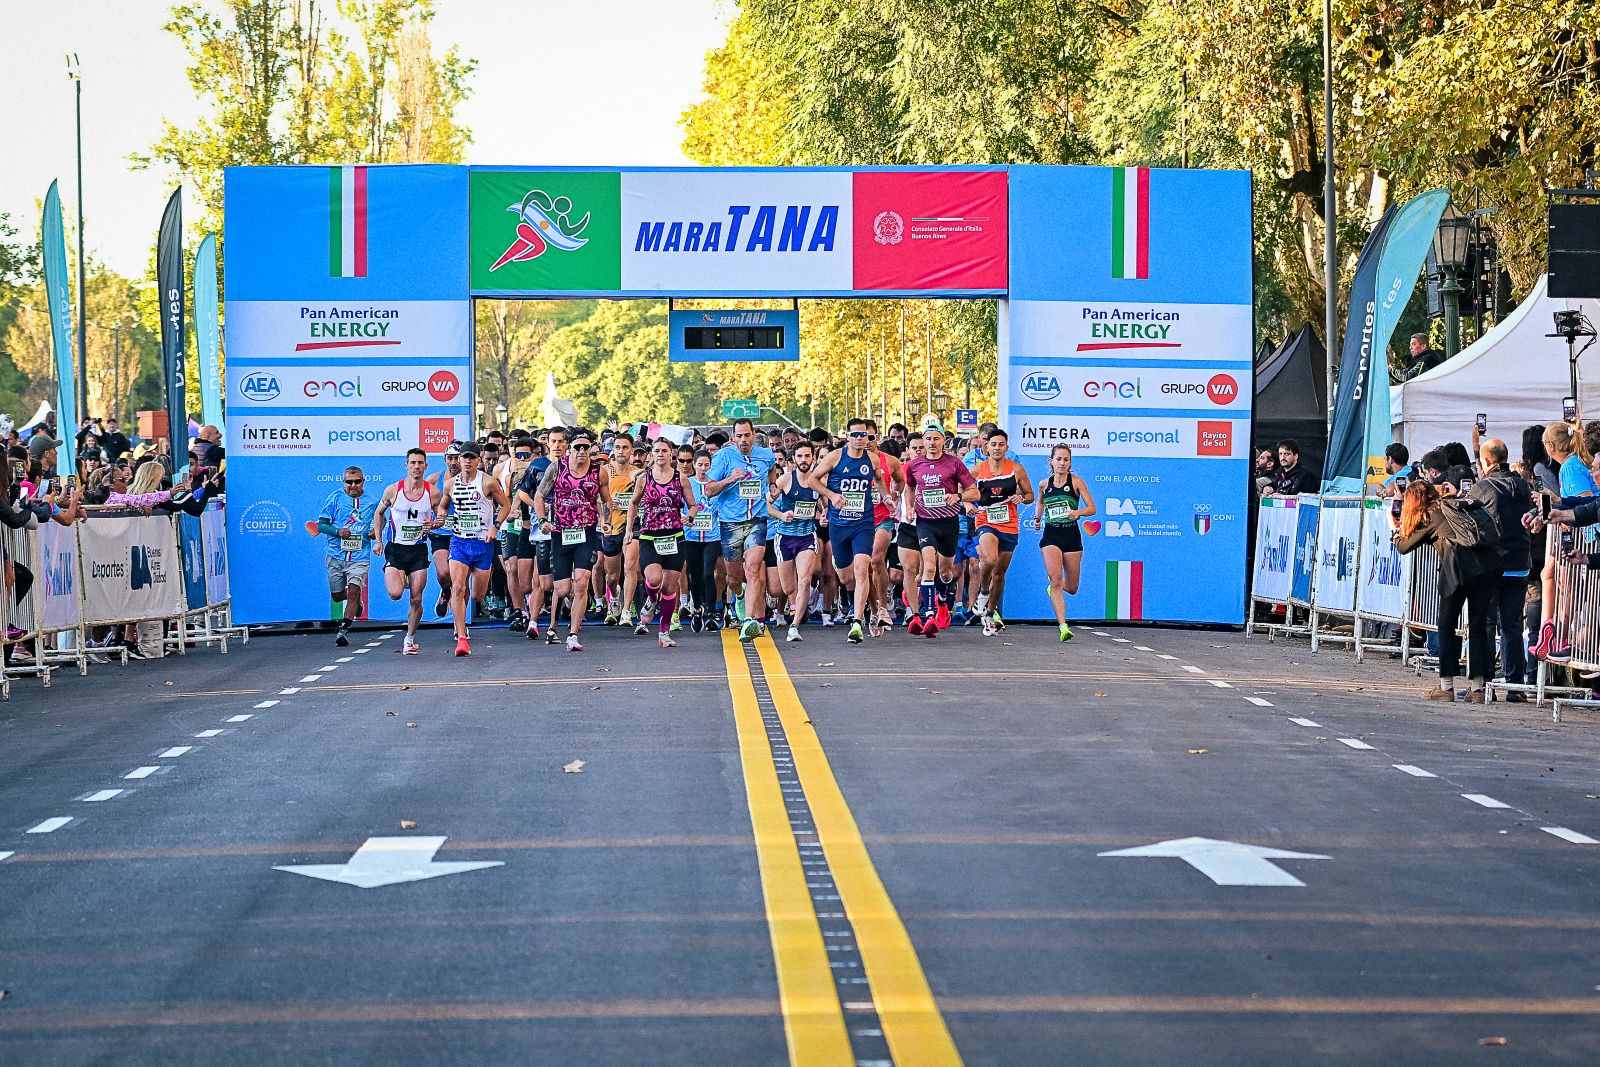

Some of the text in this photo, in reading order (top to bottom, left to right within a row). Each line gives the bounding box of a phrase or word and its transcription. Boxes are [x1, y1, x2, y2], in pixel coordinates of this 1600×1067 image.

[300, 307, 399, 319] Pan American
[1082, 307, 1180, 321] Pan American
[310, 322, 390, 338] ENERGY
[1091, 323, 1171, 339] ENERGY
[244, 377, 280, 393] AEA
[303, 376, 362, 398] enel
[381, 381, 455, 392] GRUPO VIA
[1024, 376, 1061, 392] AEA
[1083, 377, 1142, 399] enel
[1160, 383, 1234, 395] GRUPO VIA
[242, 423, 312, 440] ÍNTEGRA
[328, 427, 401, 445] personal
[424, 428, 450, 437] Rayito
[1022, 422, 1090, 440] ÍNTEGRA
[1107, 429, 1180, 446] personal
[1202, 431, 1227, 440] Rayito
[425, 436, 449, 444] de Sol
[1214, 439, 1227, 447] Sol
[840, 479, 868, 492] CDC
[1095, 475, 1112, 483] CON
[245, 521, 287, 529] COMITES
